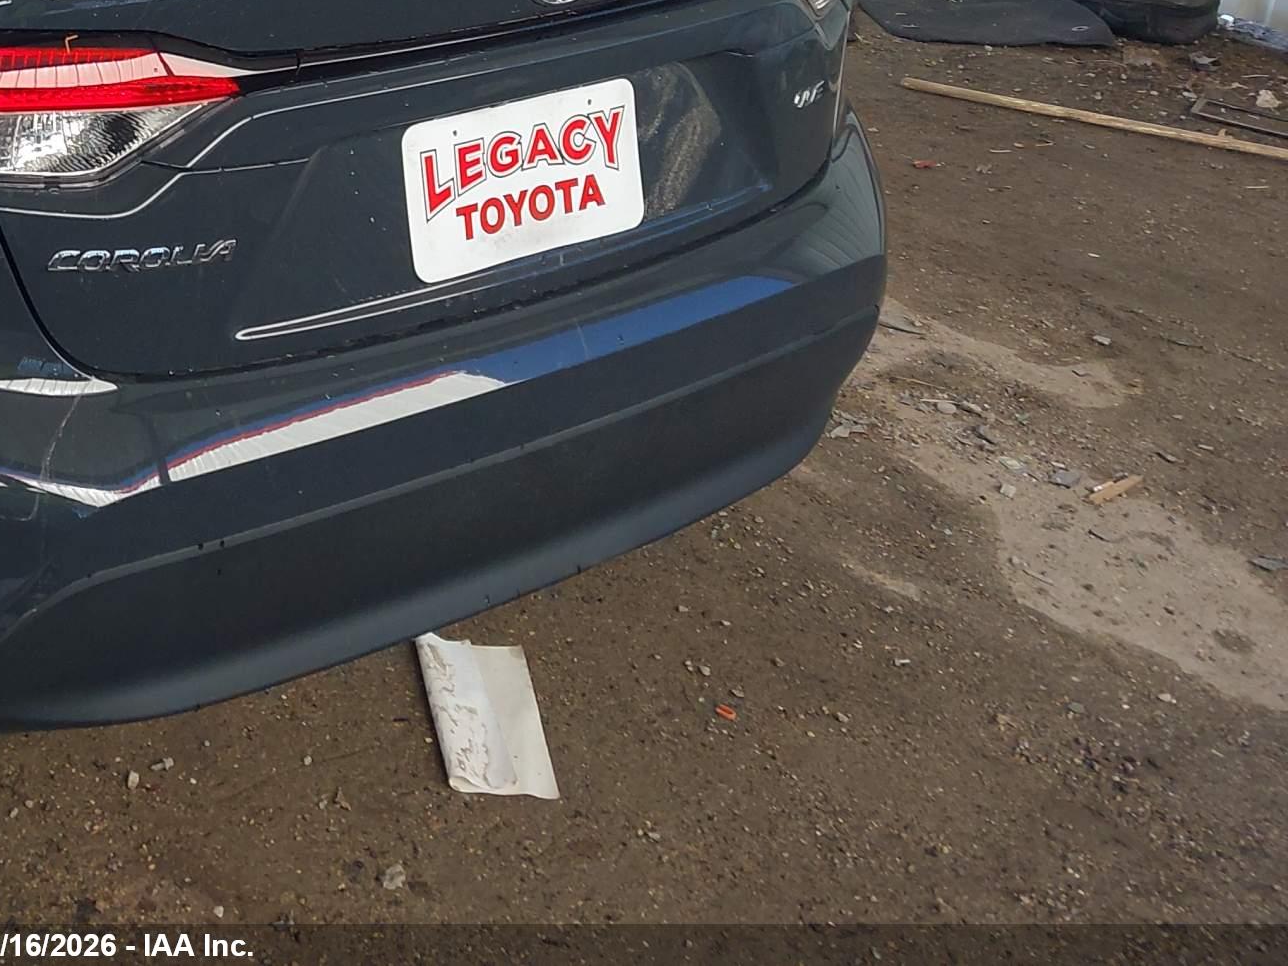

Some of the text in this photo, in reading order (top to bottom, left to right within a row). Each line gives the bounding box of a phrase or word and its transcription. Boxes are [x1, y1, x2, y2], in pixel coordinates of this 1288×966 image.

[420, 105, 625, 223] LEGACY
[455, 174, 606, 241] TOYOTA
[47, 239, 237, 272] COROLLA
